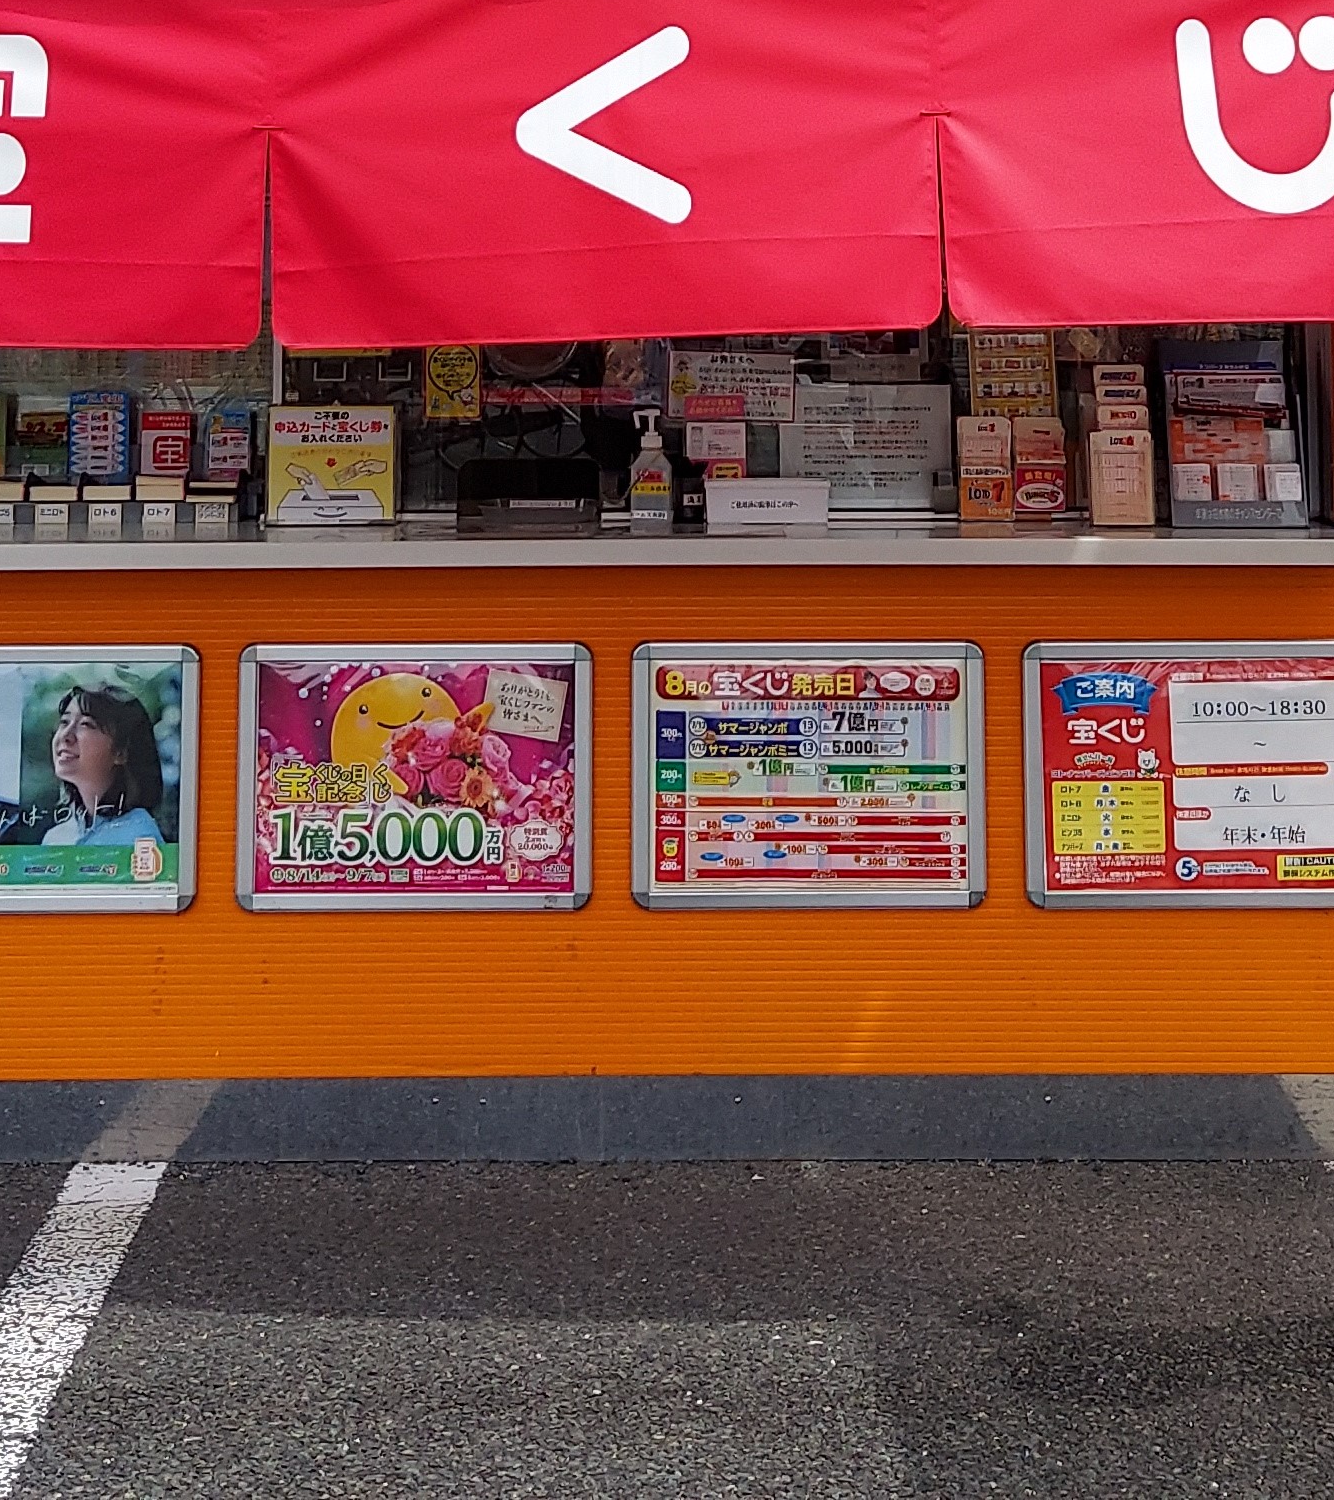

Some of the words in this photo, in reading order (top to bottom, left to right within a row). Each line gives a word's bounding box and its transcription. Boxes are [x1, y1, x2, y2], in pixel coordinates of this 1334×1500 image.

[300, 433, 363, 444] お入れください
[93, 507, 117, 517] ロト6
[665, 670, 856, 697] 8月の宝くじ発売日
[1075, 678, 1135, 700] ご案内
[718, 722, 788, 735] サマージャンボ
[1066, 718, 1146, 745] 宝くじ
[709, 744, 798, 757] サマージャンボミニ
[1222, 824, 1307, 846] 年末・年始
